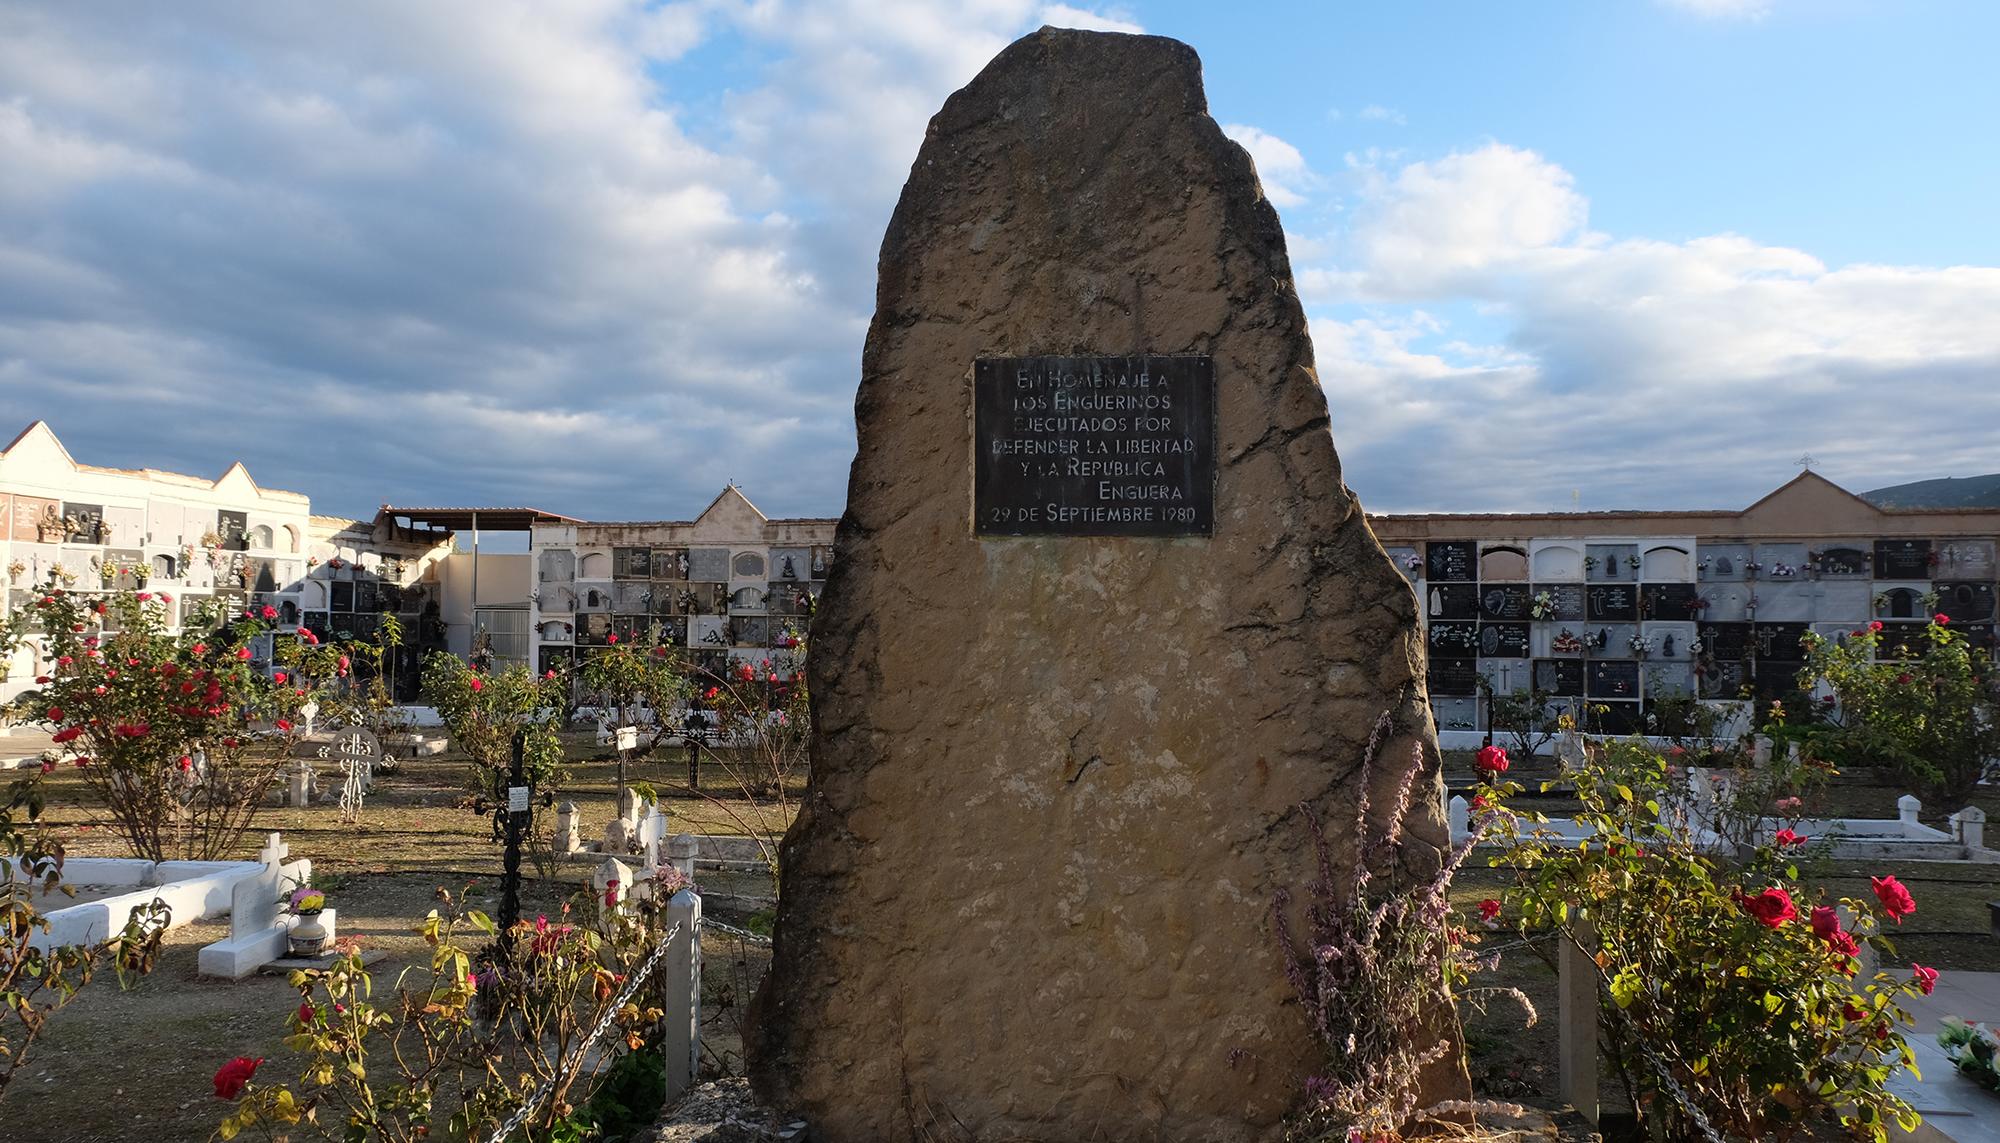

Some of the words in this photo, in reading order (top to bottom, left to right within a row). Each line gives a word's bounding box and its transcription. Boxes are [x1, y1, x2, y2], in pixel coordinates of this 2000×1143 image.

[1020, 462, 1030, 477] Y
[992, 507, 1011, 522] 29
[1018, 507, 1039, 522] DE
[1161, 507, 1196, 522] 1980
